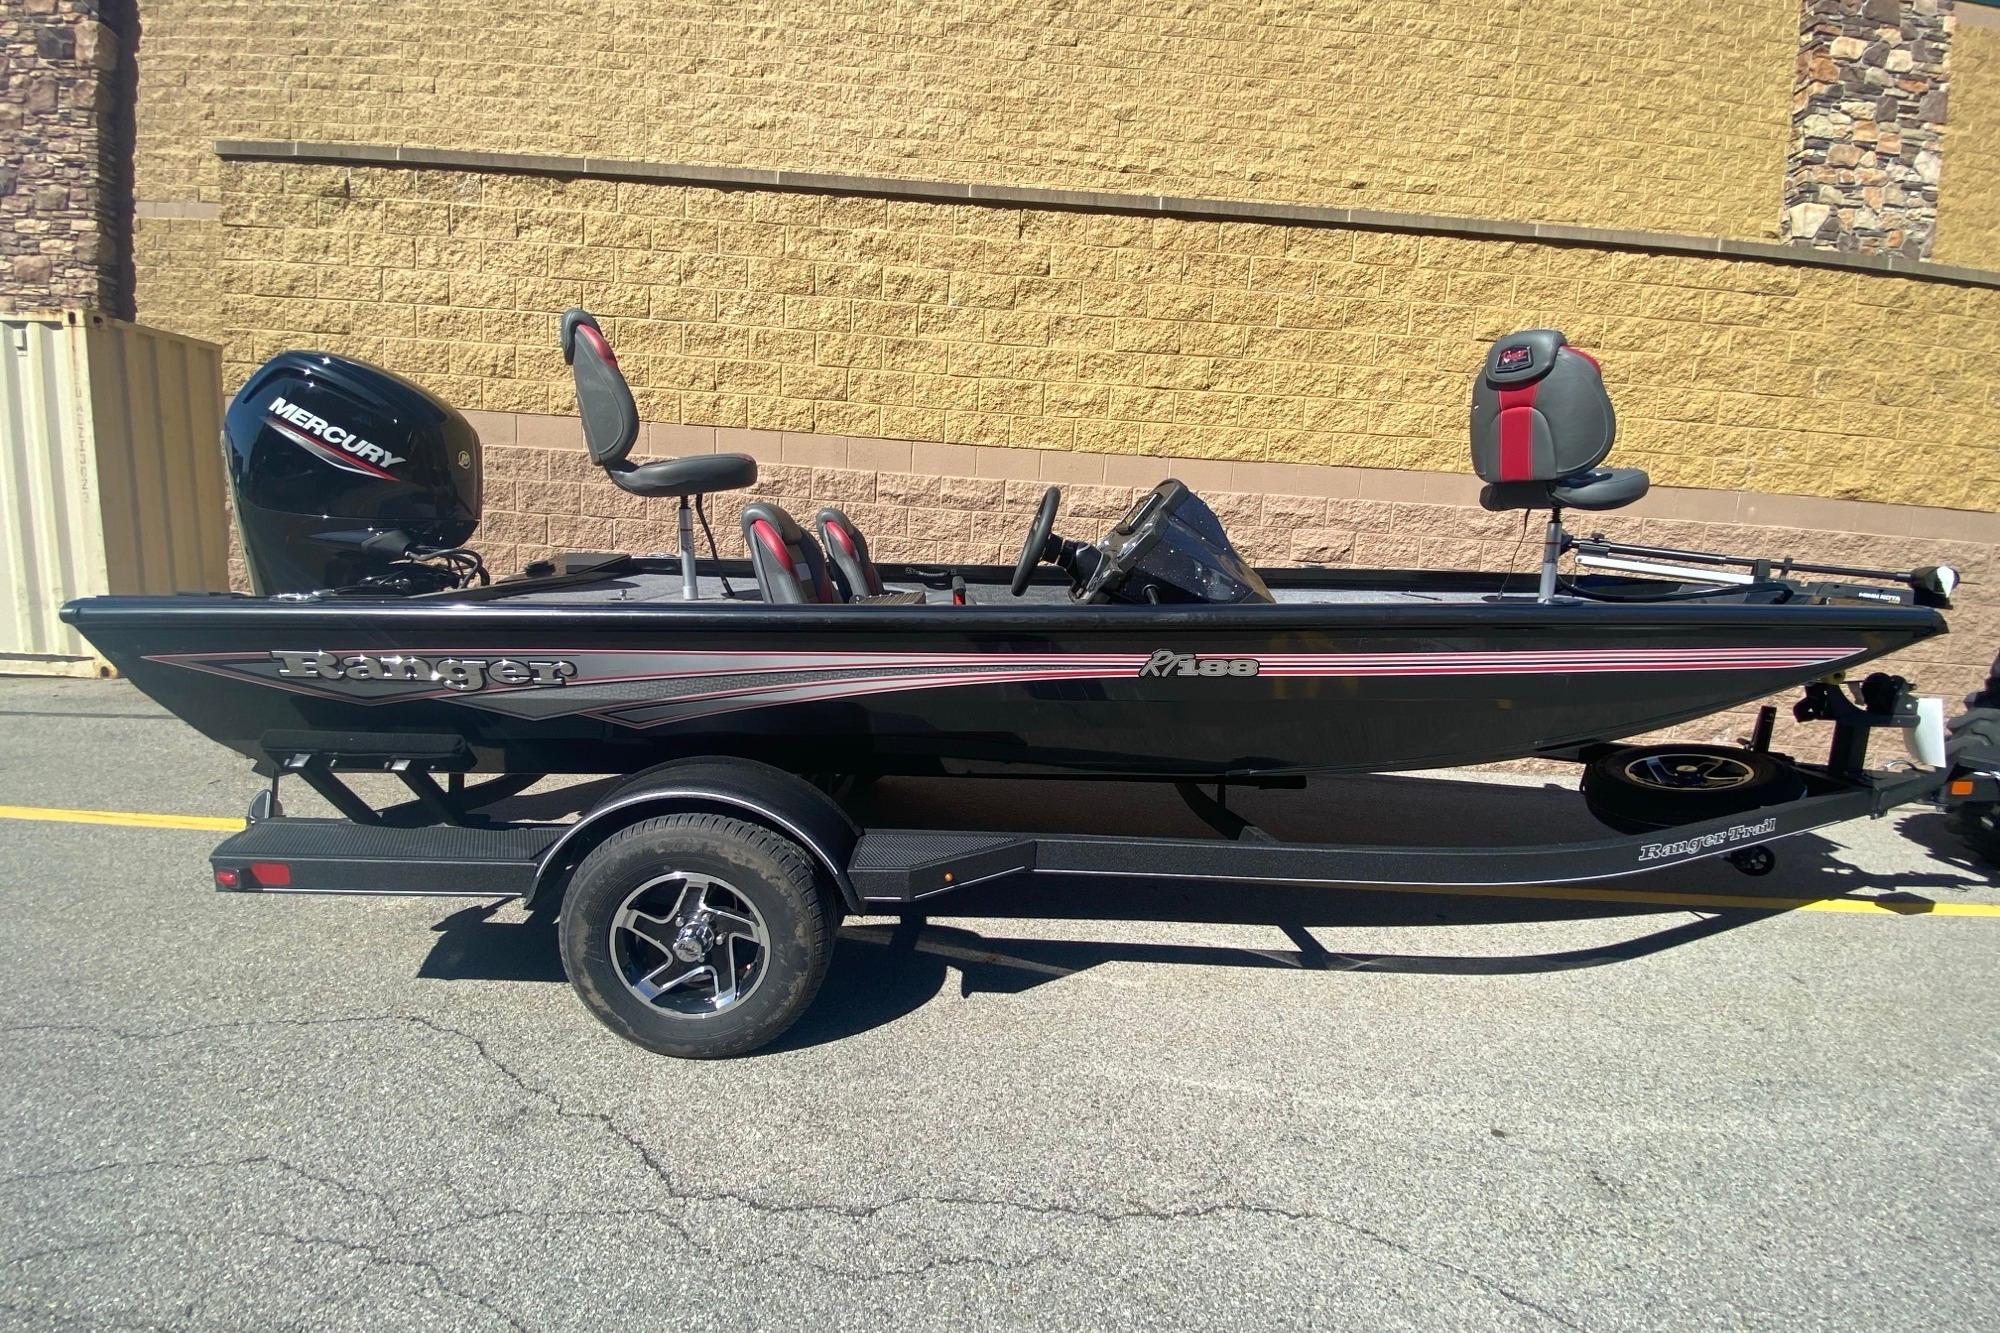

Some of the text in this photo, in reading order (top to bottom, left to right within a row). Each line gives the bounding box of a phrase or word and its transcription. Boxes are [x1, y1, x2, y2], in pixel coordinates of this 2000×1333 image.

[268, 397, 406, 468] MERCURY
[270, 650, 577, 692] Ranger
[1638, 818, 1776, 861] Ranger Trail
